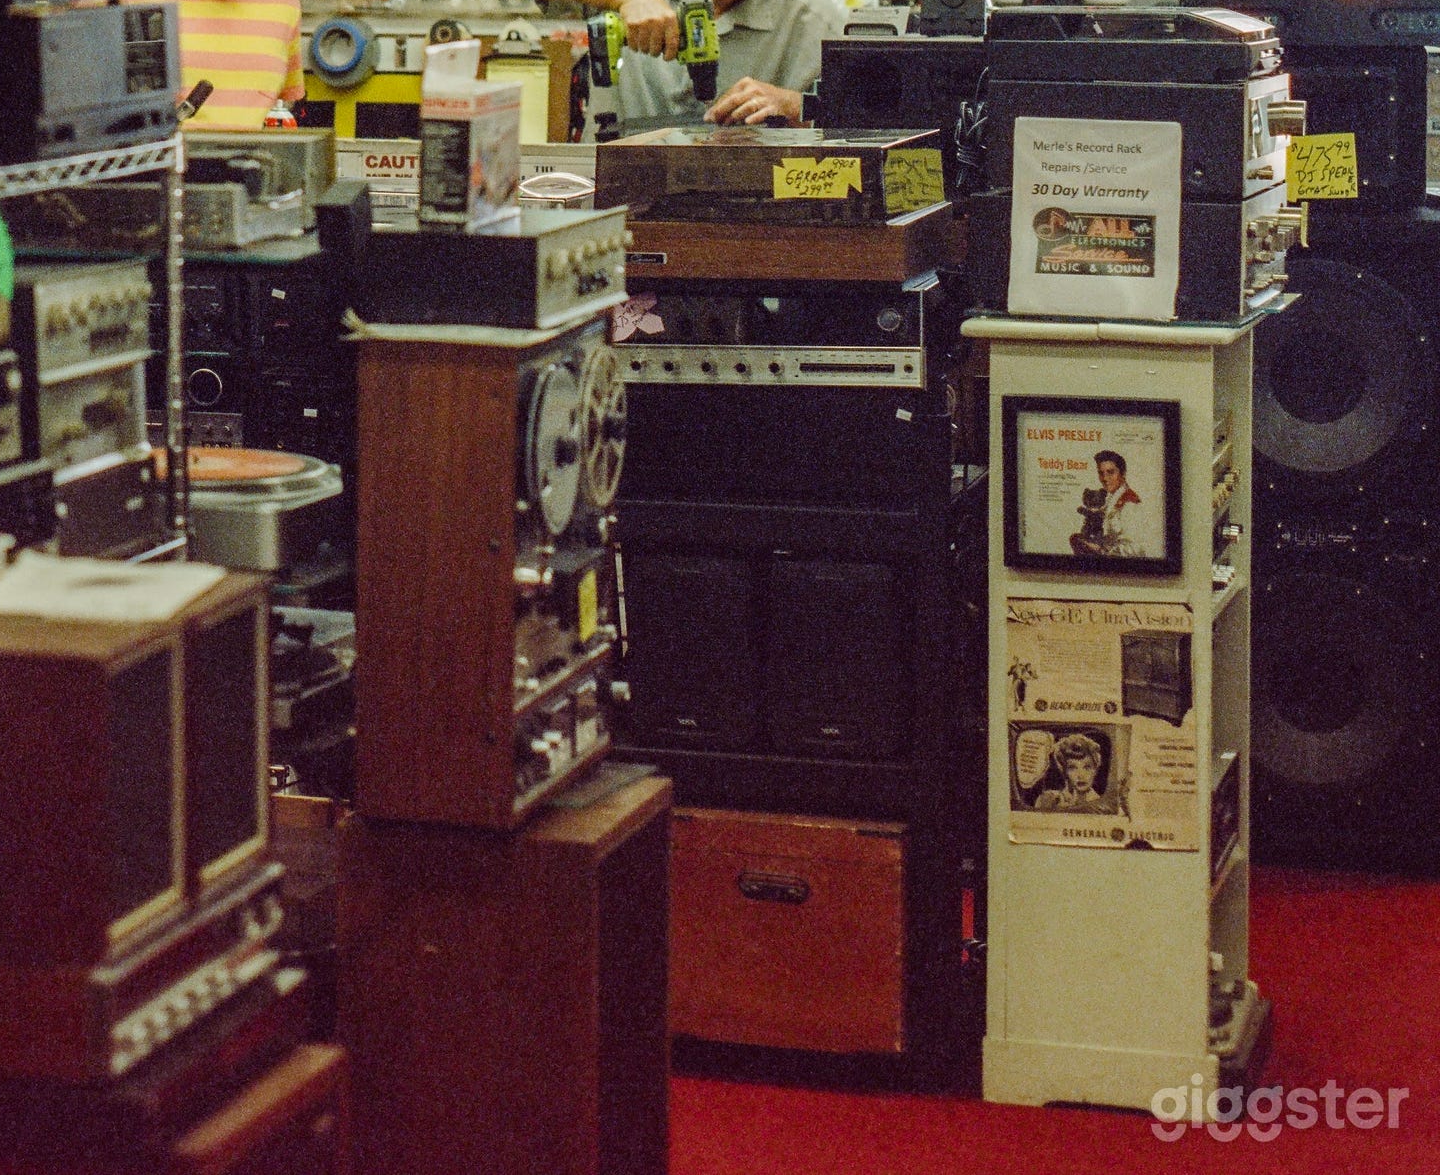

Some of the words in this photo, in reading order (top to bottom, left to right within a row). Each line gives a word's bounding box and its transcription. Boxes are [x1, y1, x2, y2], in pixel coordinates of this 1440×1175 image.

[1033, 140, 1073, 153] Merle's
[1076, 142, 1113, 154] Record
[1117, 143, 1142, 154] Rack
[1041, 162, 1081, 175] Repairs
[1083, 163, 1128, 175] /Service
[1031, 183, 1049, 196] 30
[1052, 184, 1079, 199] Day
[1083, 185, 1150, 200] Warranty
[1071, 237, 1146, 247] ELECTRONICS
[1040, 261, 1081, 272] MUSIC
[1089, 264, 1098, 272] &
[1106, 265, 1151, 275] SOUND
[1027, 429, 1055, 440] ELVIS
[1059, 429, 1102, 442] PRESLEY
[1037, 458, 1064, 471] Teddy
[1067, 460, 1088, 470] Bear
[1049, 607, 1082, 624] GE
[1062, 827, 1106, 839] GENERAL
[1128, 830, 1175, 841] ELECTRIC
